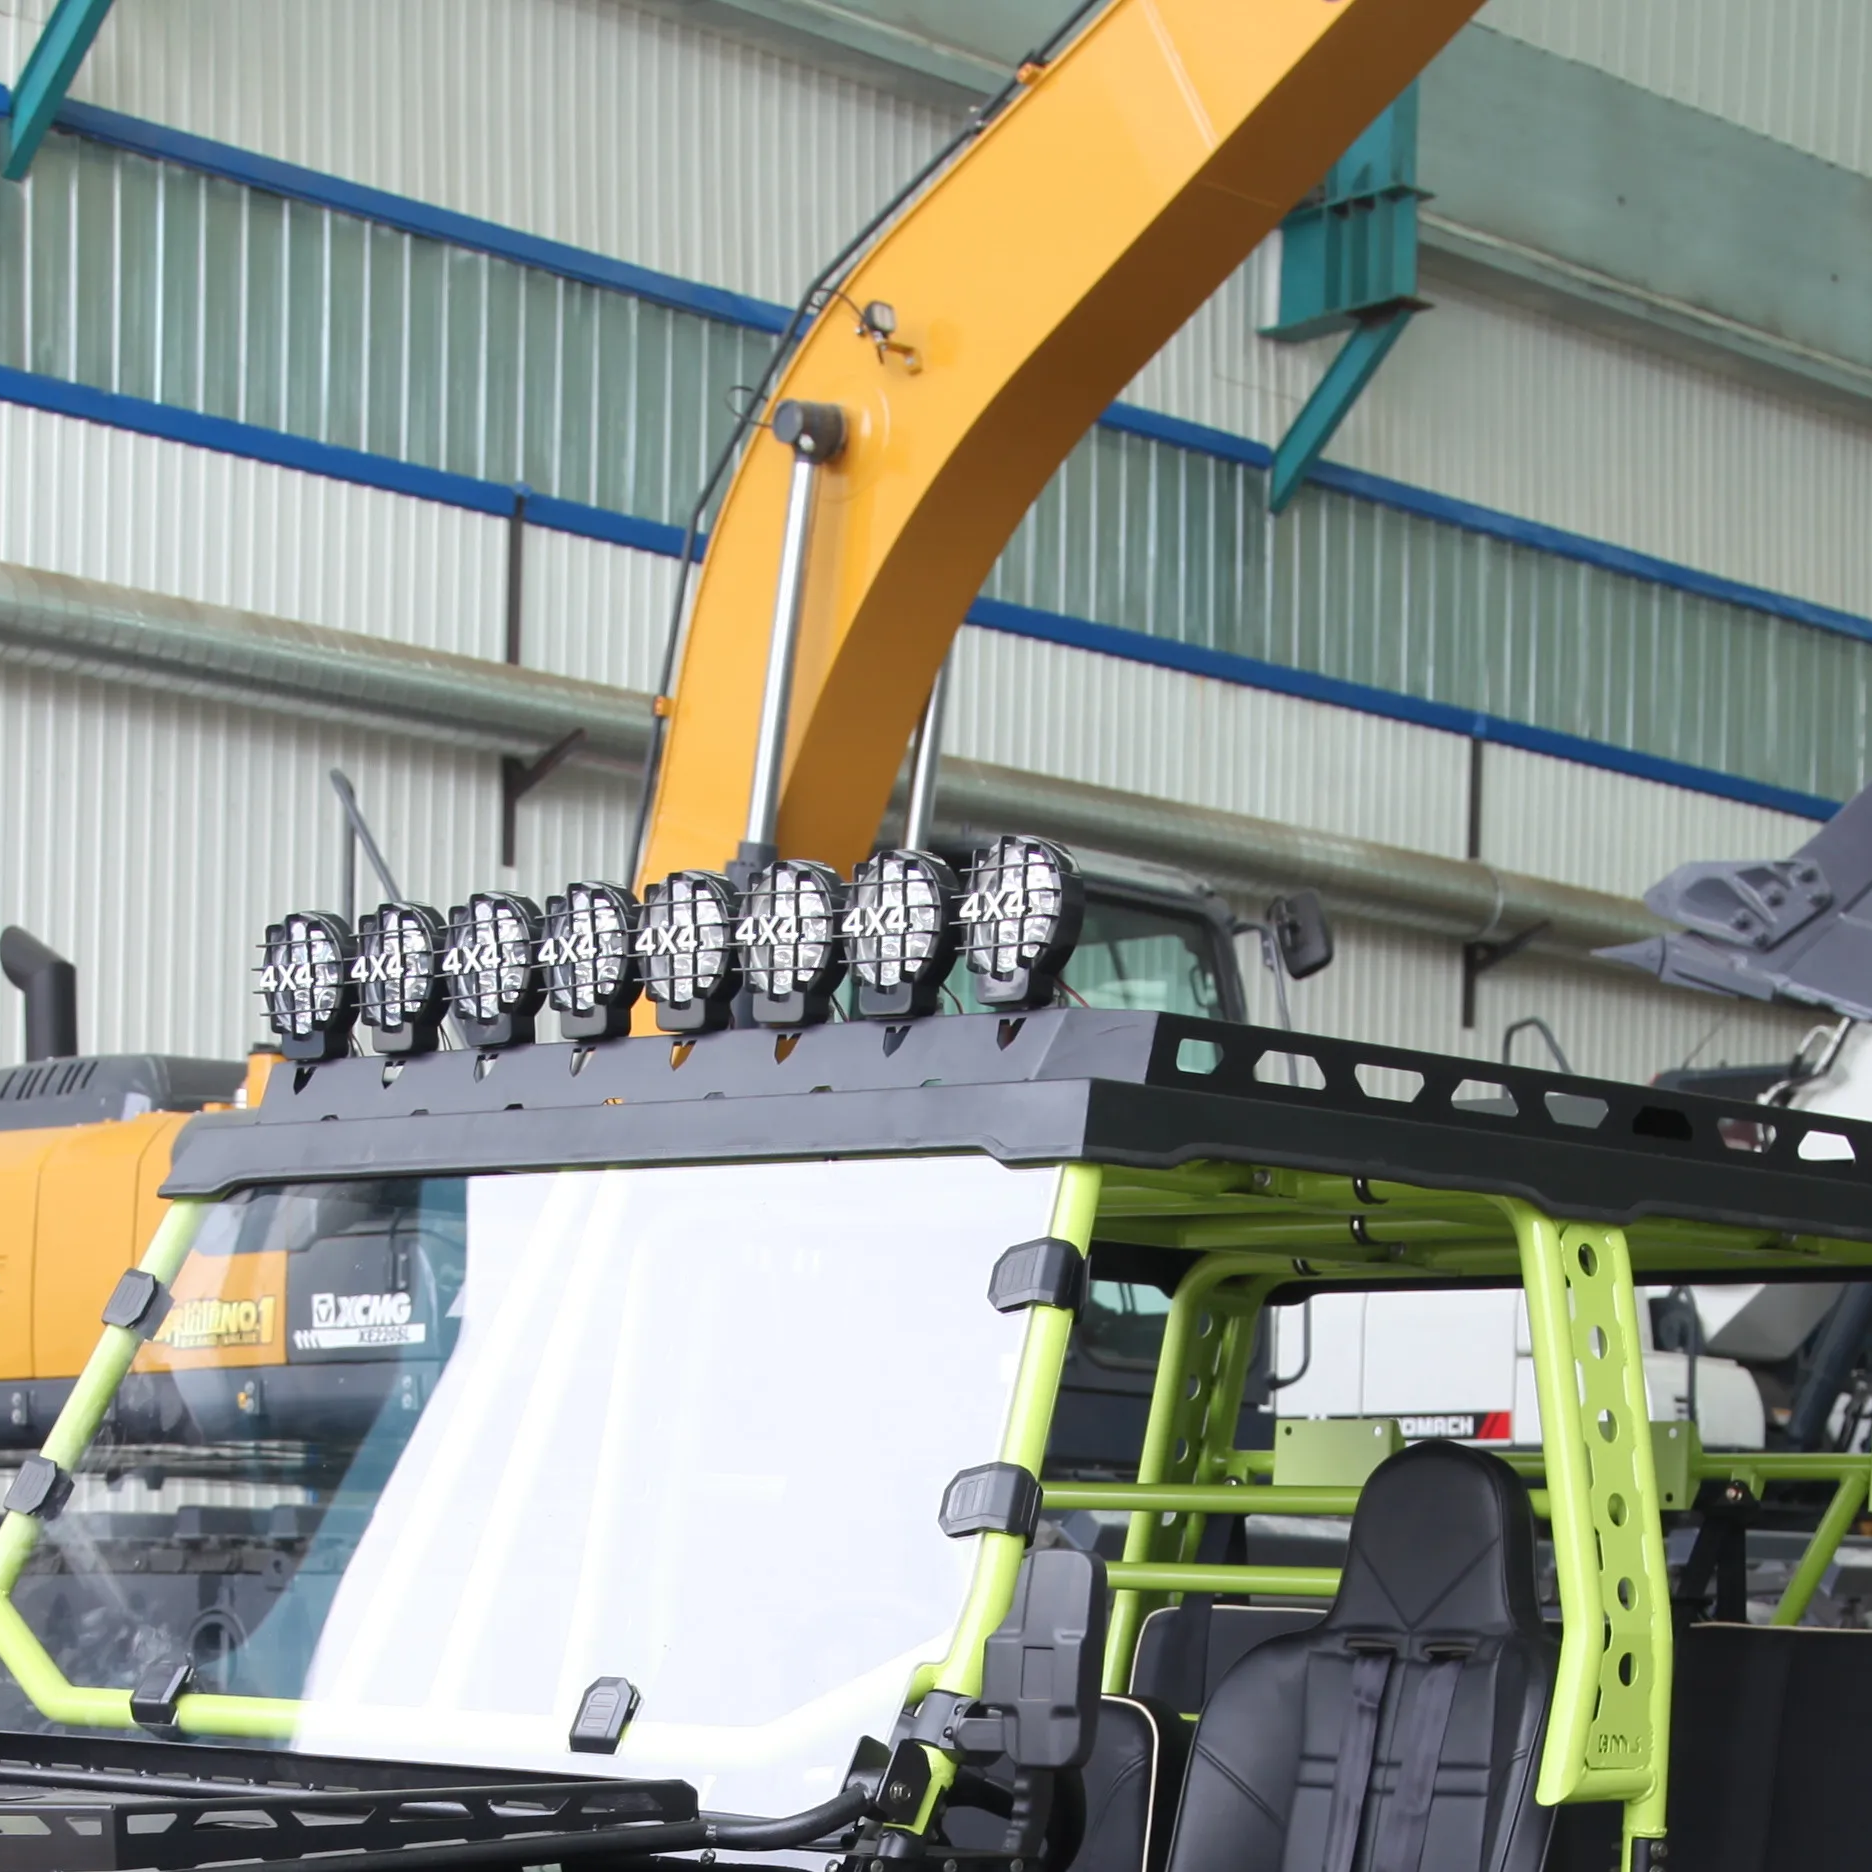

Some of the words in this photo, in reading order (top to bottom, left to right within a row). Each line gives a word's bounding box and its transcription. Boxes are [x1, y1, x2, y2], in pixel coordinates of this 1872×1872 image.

[842, 905, 908, 938] 4X4
[959, 889, 1026, 923] 4X4
[635, 923, 698, 957] 4X4
[736, 914, 800, 946] 4X4
[442, 944, 501, 975] 4X4
[538, 934, 598, 967] 4X4
[260, 966, 314, 993] 4X4
[352, 953, 405, 984] 4X4
[336, 1292, 411, 1327] XCMG
[1397, 1415, 1475, 1438] OMACH
